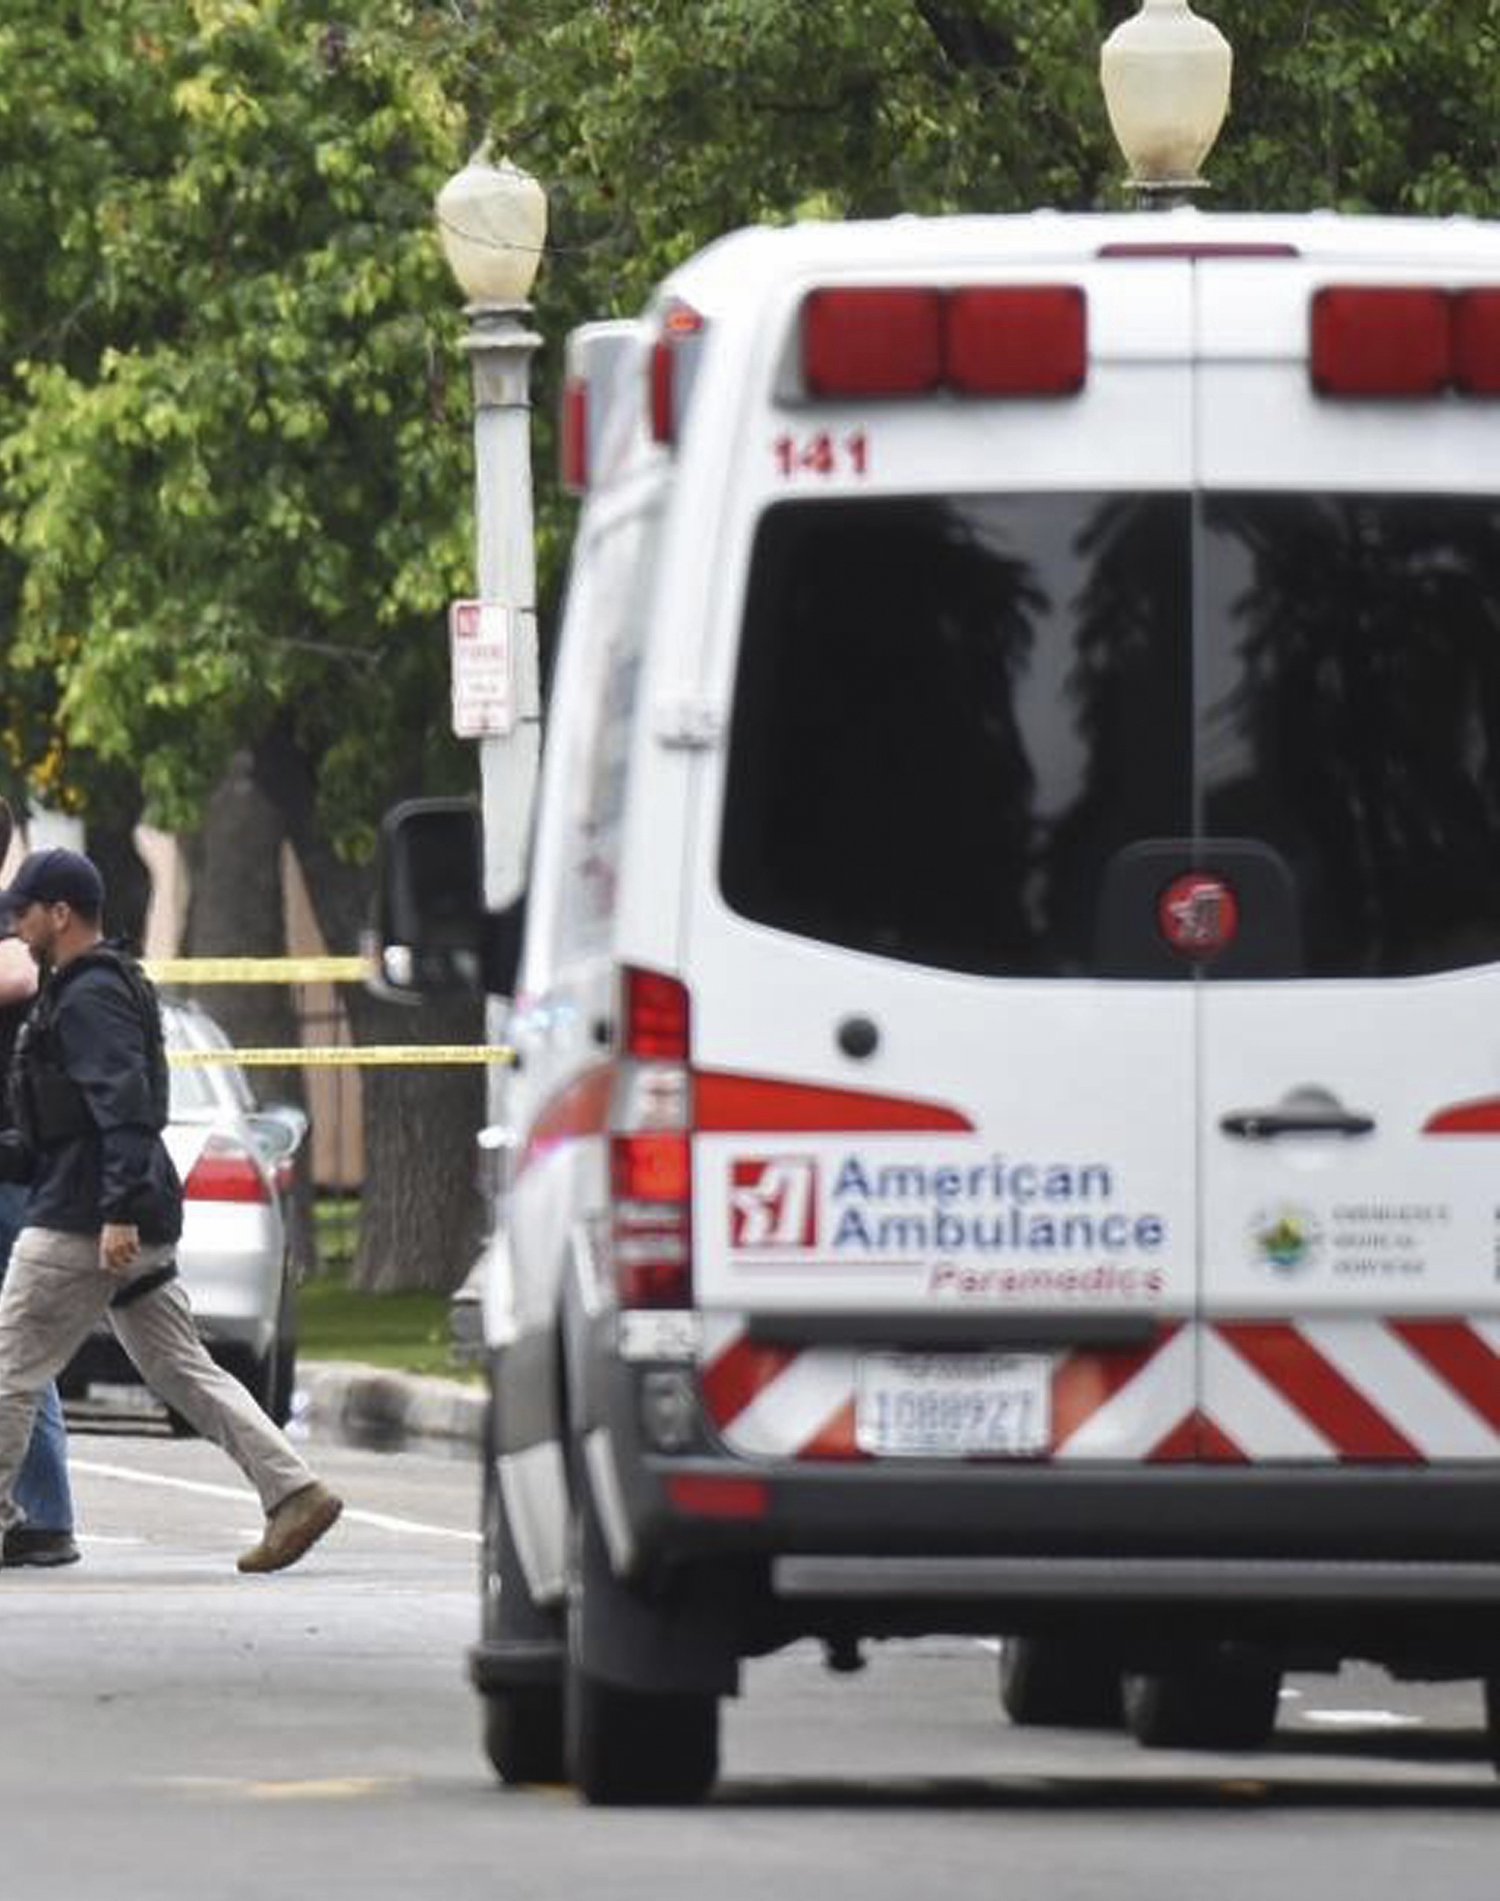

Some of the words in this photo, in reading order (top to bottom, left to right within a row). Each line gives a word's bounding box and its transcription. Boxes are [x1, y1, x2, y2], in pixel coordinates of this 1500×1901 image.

[773, 434, 867, 474] 141
[832, 1157, 1113, 1199] American
[832, 1208, 1164, 1250] Ambulance
[928, 1265, 1165, 1295] Paramedics
